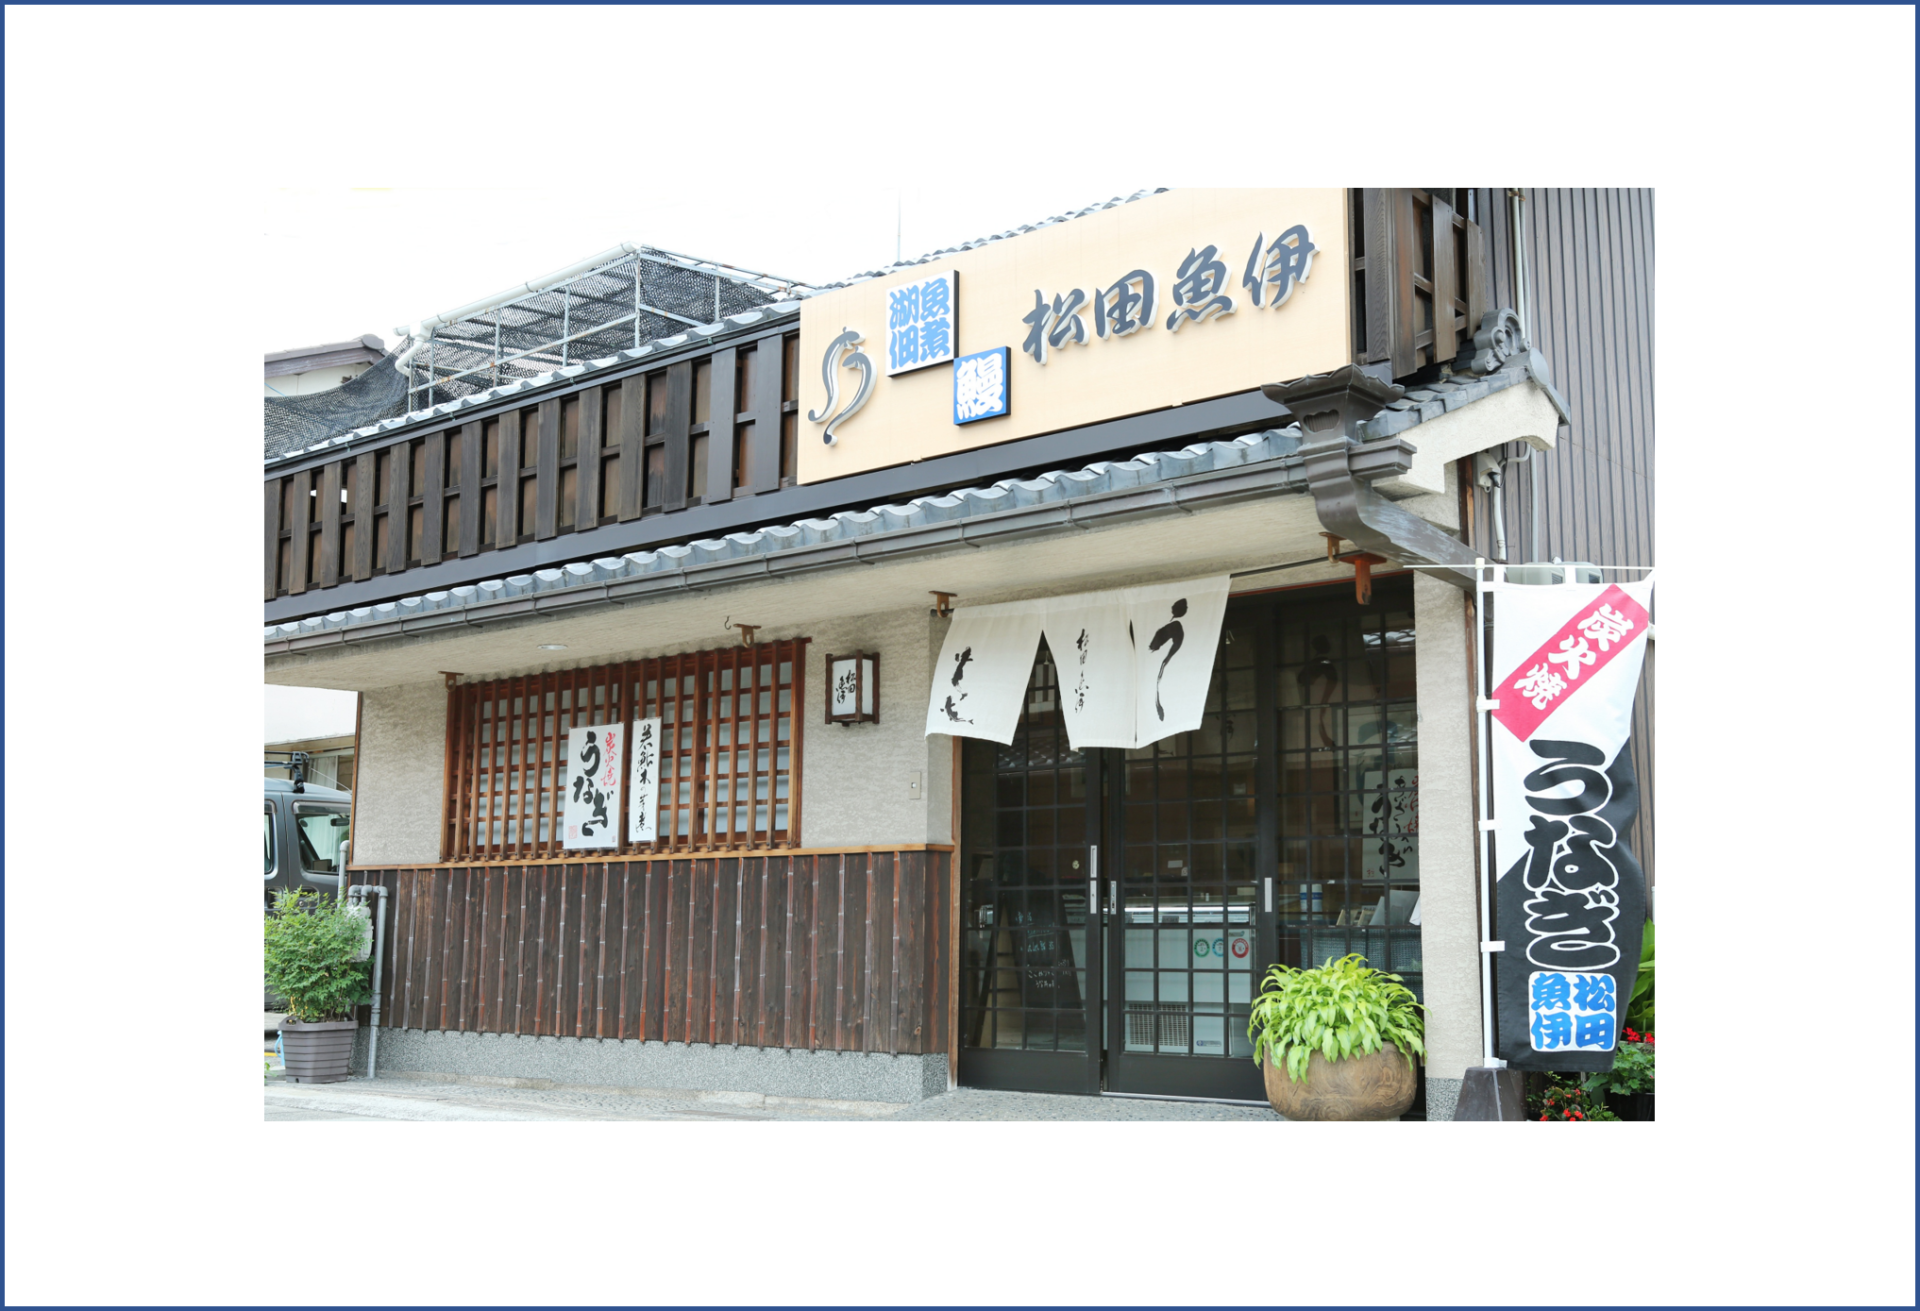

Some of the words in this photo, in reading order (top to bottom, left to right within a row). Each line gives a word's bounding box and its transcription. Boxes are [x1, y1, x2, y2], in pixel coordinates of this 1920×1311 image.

[889, 277, 950, 330] 湖魚
[1021, 224, 1320, 364] 松田魚伊
[889, 317, 950, 370] 佃煮
[956, 352, 1004, 420] 鰻
[1513, 602, 1635, 711] 炭火焼
[573, 730, 615, 837] うなぎ
[1522, 738, 1621, 971] うなぎ
[1530, 971, 1572, 1050] 魚伊
[1572, 973, 1616, 1050] 松田
